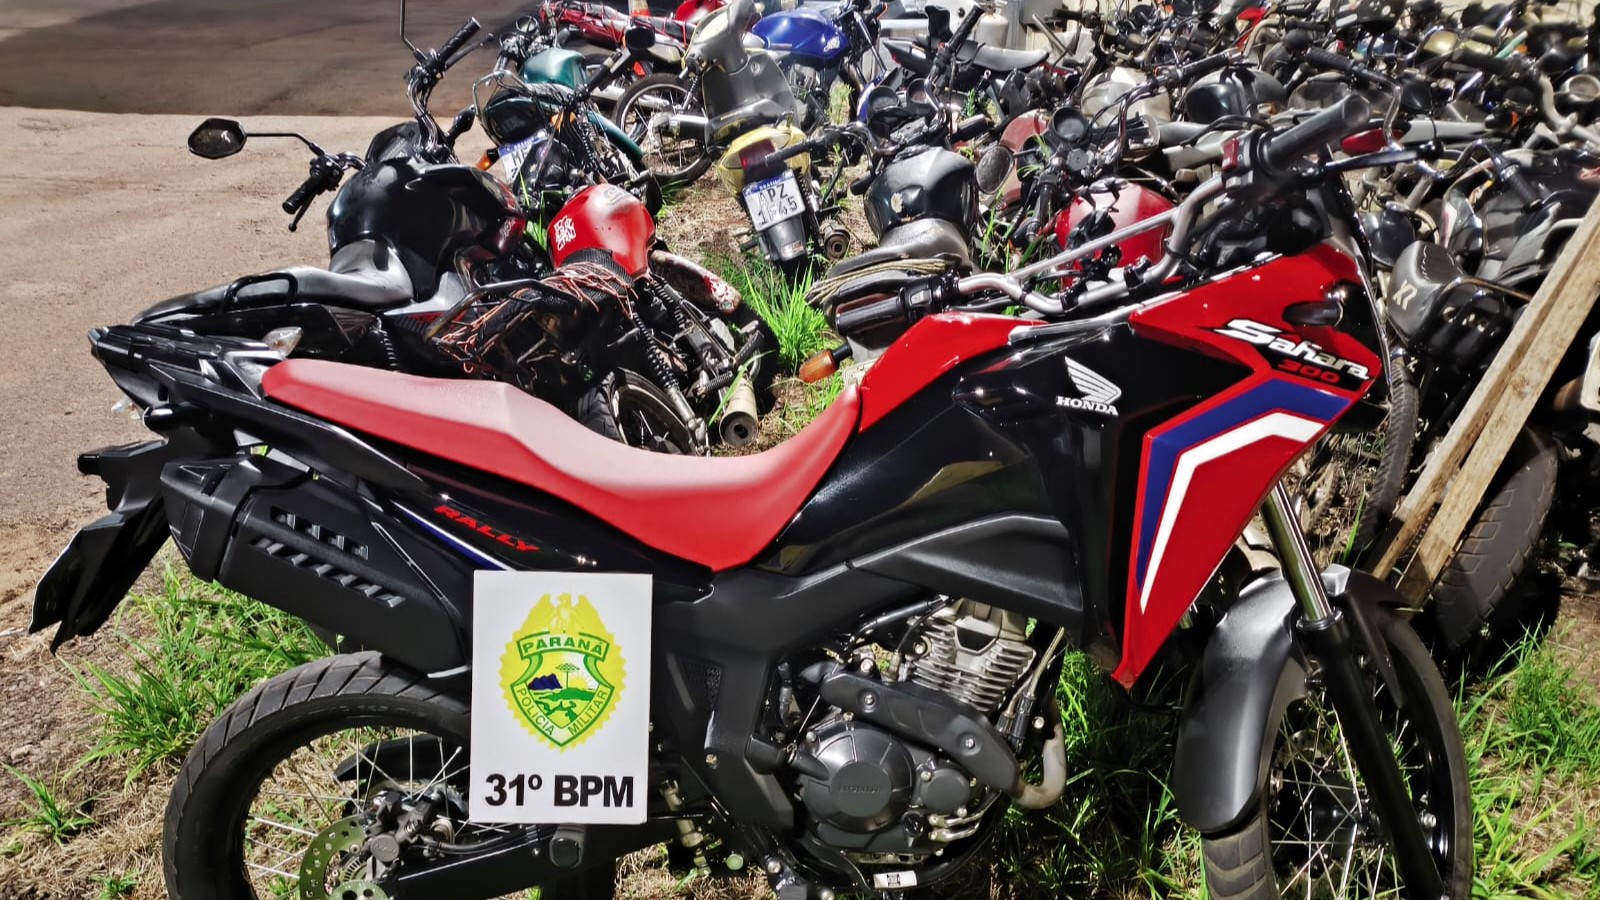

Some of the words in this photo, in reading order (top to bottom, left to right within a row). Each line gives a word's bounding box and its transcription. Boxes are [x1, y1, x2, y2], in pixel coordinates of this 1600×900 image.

[758, 183, 788, 208] APZ
[1213, 319, 1369, 380] Sahara
[1278, 358, 1341, 384] 300
[1056, 395, 1119, 416] HONDA
[434, 505, 540, 551] RALLY
[522, 636, 603, 655] PARANÁ
[567, 690, 608, 736] MILITAR
[554, 774, 634, 808] BPM
